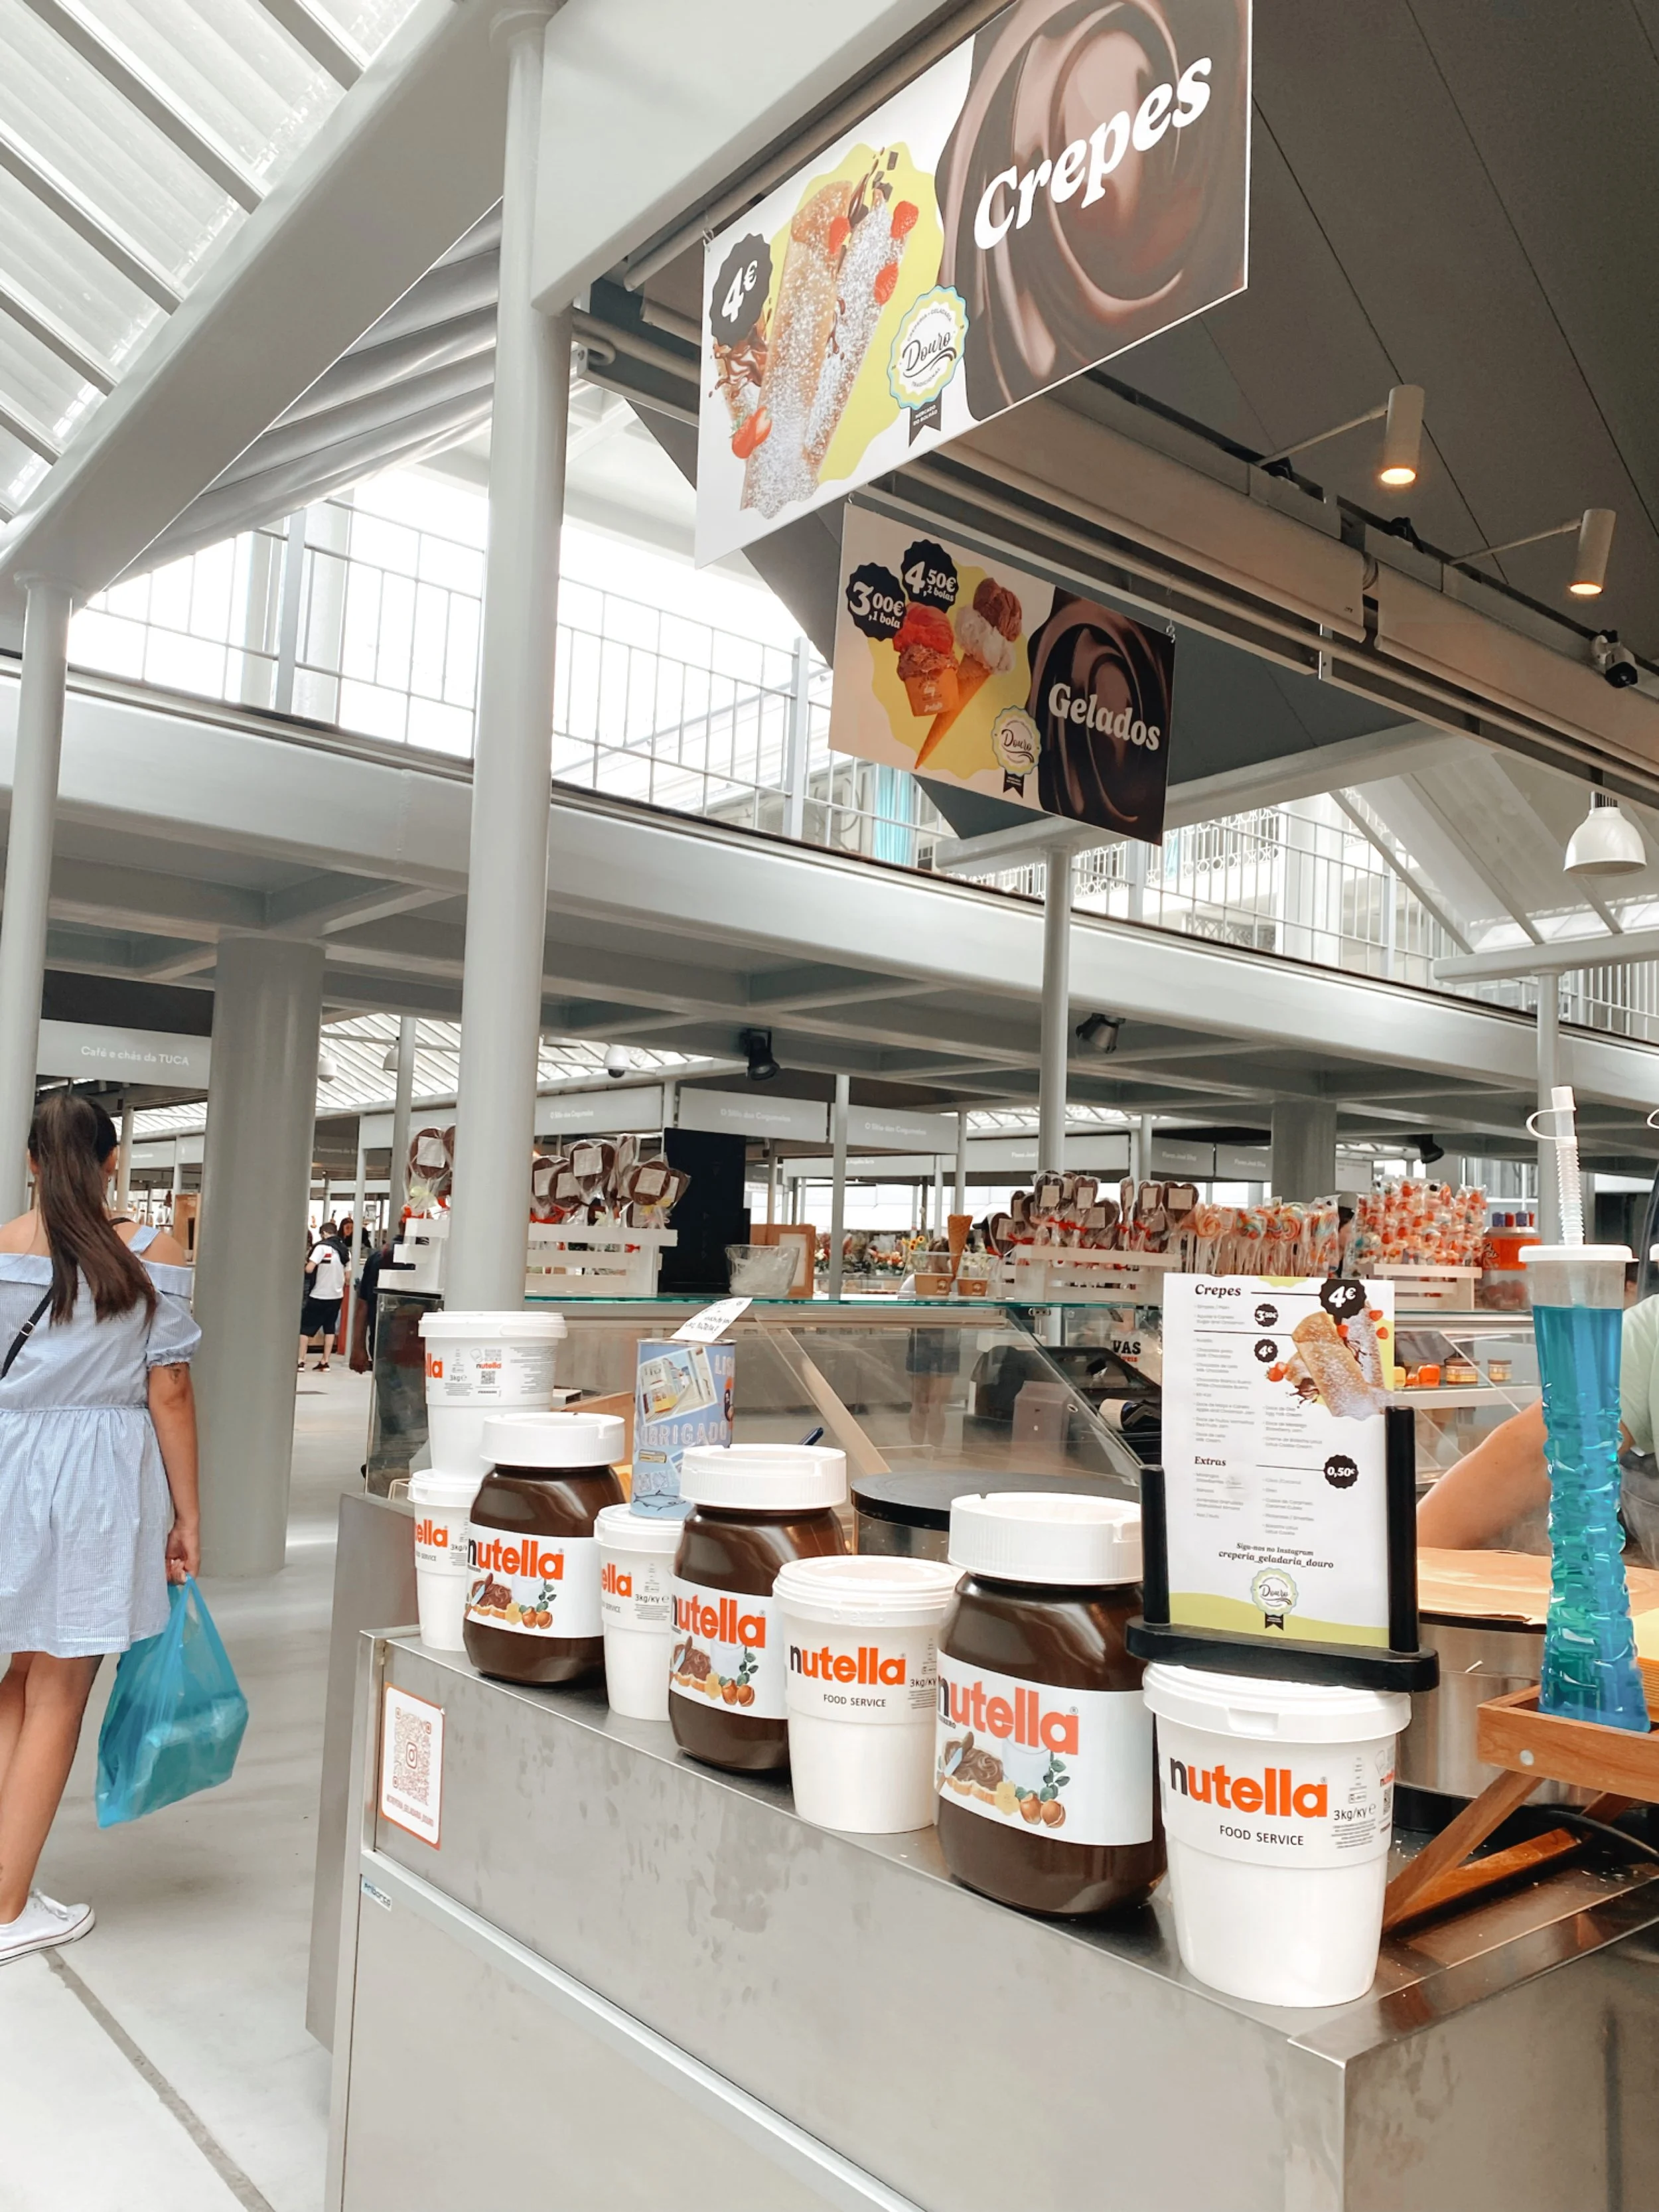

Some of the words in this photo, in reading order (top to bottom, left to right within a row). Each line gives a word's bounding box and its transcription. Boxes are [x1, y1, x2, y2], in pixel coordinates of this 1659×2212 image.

[974, 56, 1212, 251] Crepes
[721, 259, 758, 323] 4€
[902, 332, 951, 371] Douro
[934, 587, 954, 602] bolas
[880, 613, 900, 628] bola
[1048, 682, 1161, 751] Gelados
[81, 1046, 107, 1057] Café
[117, 1051, 141, 1061] chás
[144, 1052, 157, 1063] da
[159, 1053, 189, 1066] TUCA
[1195, 1284, 1241, 1298] Crepes
[1329, 1286, 1356, 1308] 4€
[1114, 1340, 1141, 1355] VAS
[1258, 1345, 1274, 1357] 4€
[1194, 1456, 1226, 1466] Extras
[1327, 1466, 1355, 1478] 0,50€
[415, 1519, 448, 1548] ella
[467, 1537, 564, 1580] nutella
[1218, 1550, 1334, 1568] creperia_geladaria_douro
[1277, 1546, 1314, 1556] Instagram
[601, 1563, 632, 1597] ella
[672, 1594, 766, 1648] nutella
[790, 1645, 906, 1686] nutella
[824, 1694, 847, 1705] FOOD
[851, 1698, 887, 1707] SERVICE
[938, 1675, 1078, 1755] nutella
[1170, 1757, 1327, 1818] nutella
[1220, 1825, 1252, 1840] FOOD
[1256, 1832, 1305, 1846] SERVICE
